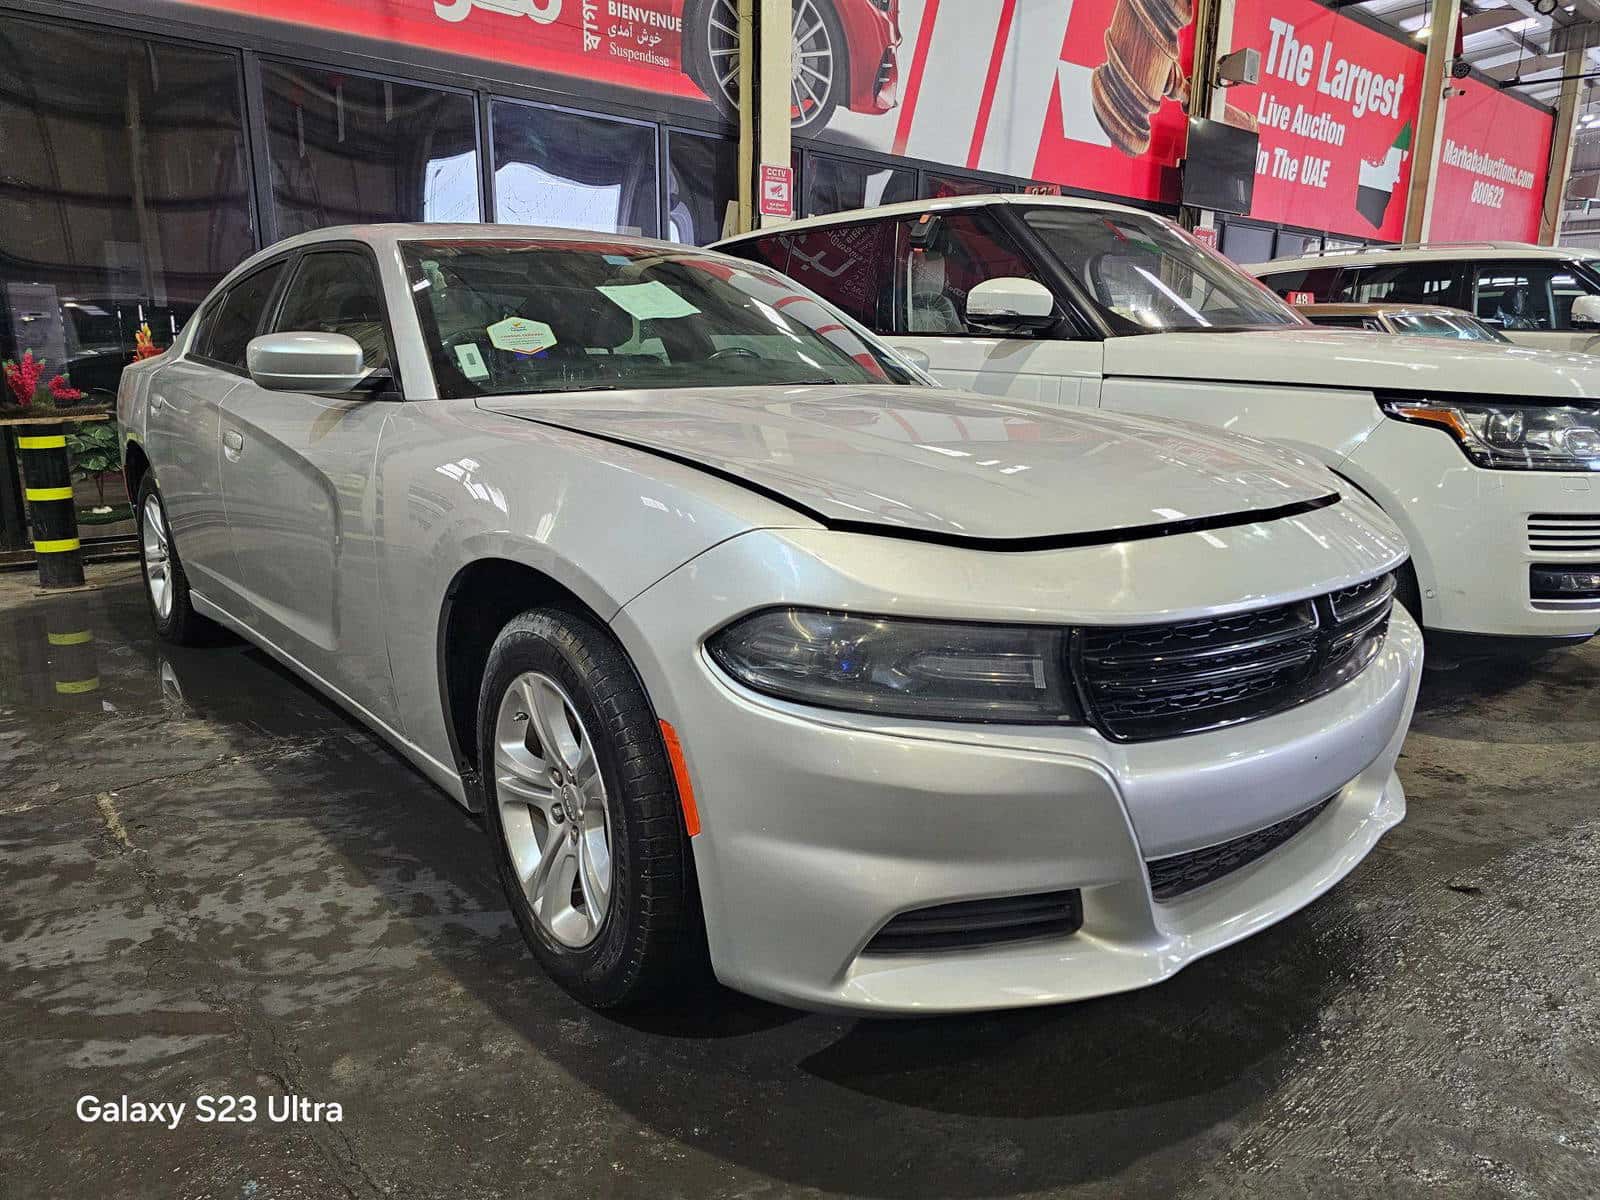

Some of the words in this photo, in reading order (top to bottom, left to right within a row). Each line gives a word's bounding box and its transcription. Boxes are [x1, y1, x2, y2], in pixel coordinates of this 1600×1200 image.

[608, 0, 683, 32] BIENVENUE
[637, 29, 662, 47] خوش
[610, 42, 670, 67] Suspendisse
[1265, 16, 1314, 87] The
[1317, 40, 1405, 119] Largest
[1257, 92, 1291, 131] Live
[1290, 104, 1346, 147] Auction
[767, 168, 787, 177] CCTV
[1271, 146, 1299, 182] The
[1300, 155, 1332, 189] UAE
[1442, 138, 1535, 190] MarhabaAuctions.com
[1471, 180, 1505, 209] 800622
